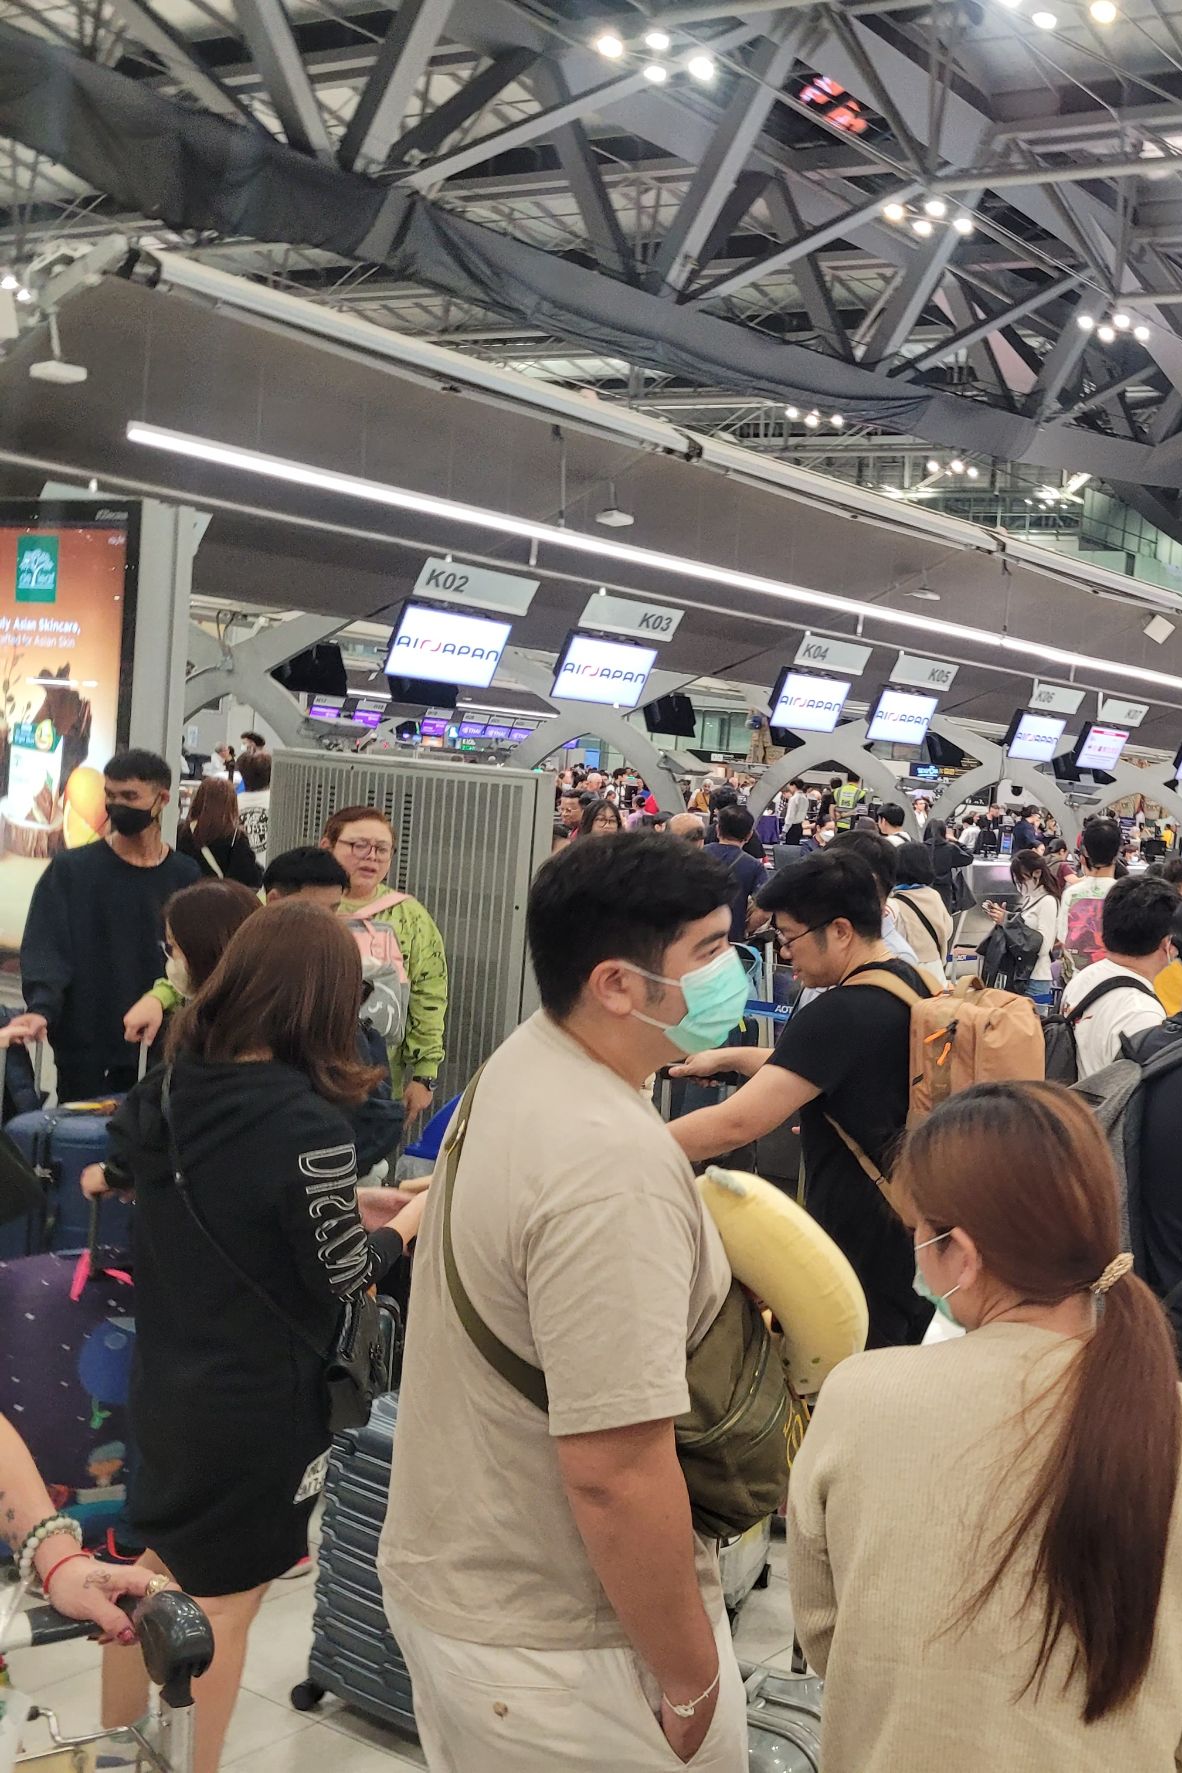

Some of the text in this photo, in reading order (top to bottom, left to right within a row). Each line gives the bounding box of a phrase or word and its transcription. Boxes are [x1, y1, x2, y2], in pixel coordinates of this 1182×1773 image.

[425, 568, 469, 593] K02
[638, 612, 673, 632] K03
[802, 643, 829, 661] K04
[928, 667, 952, 684] K05
[774, 1004, 794, 1014] AOT
